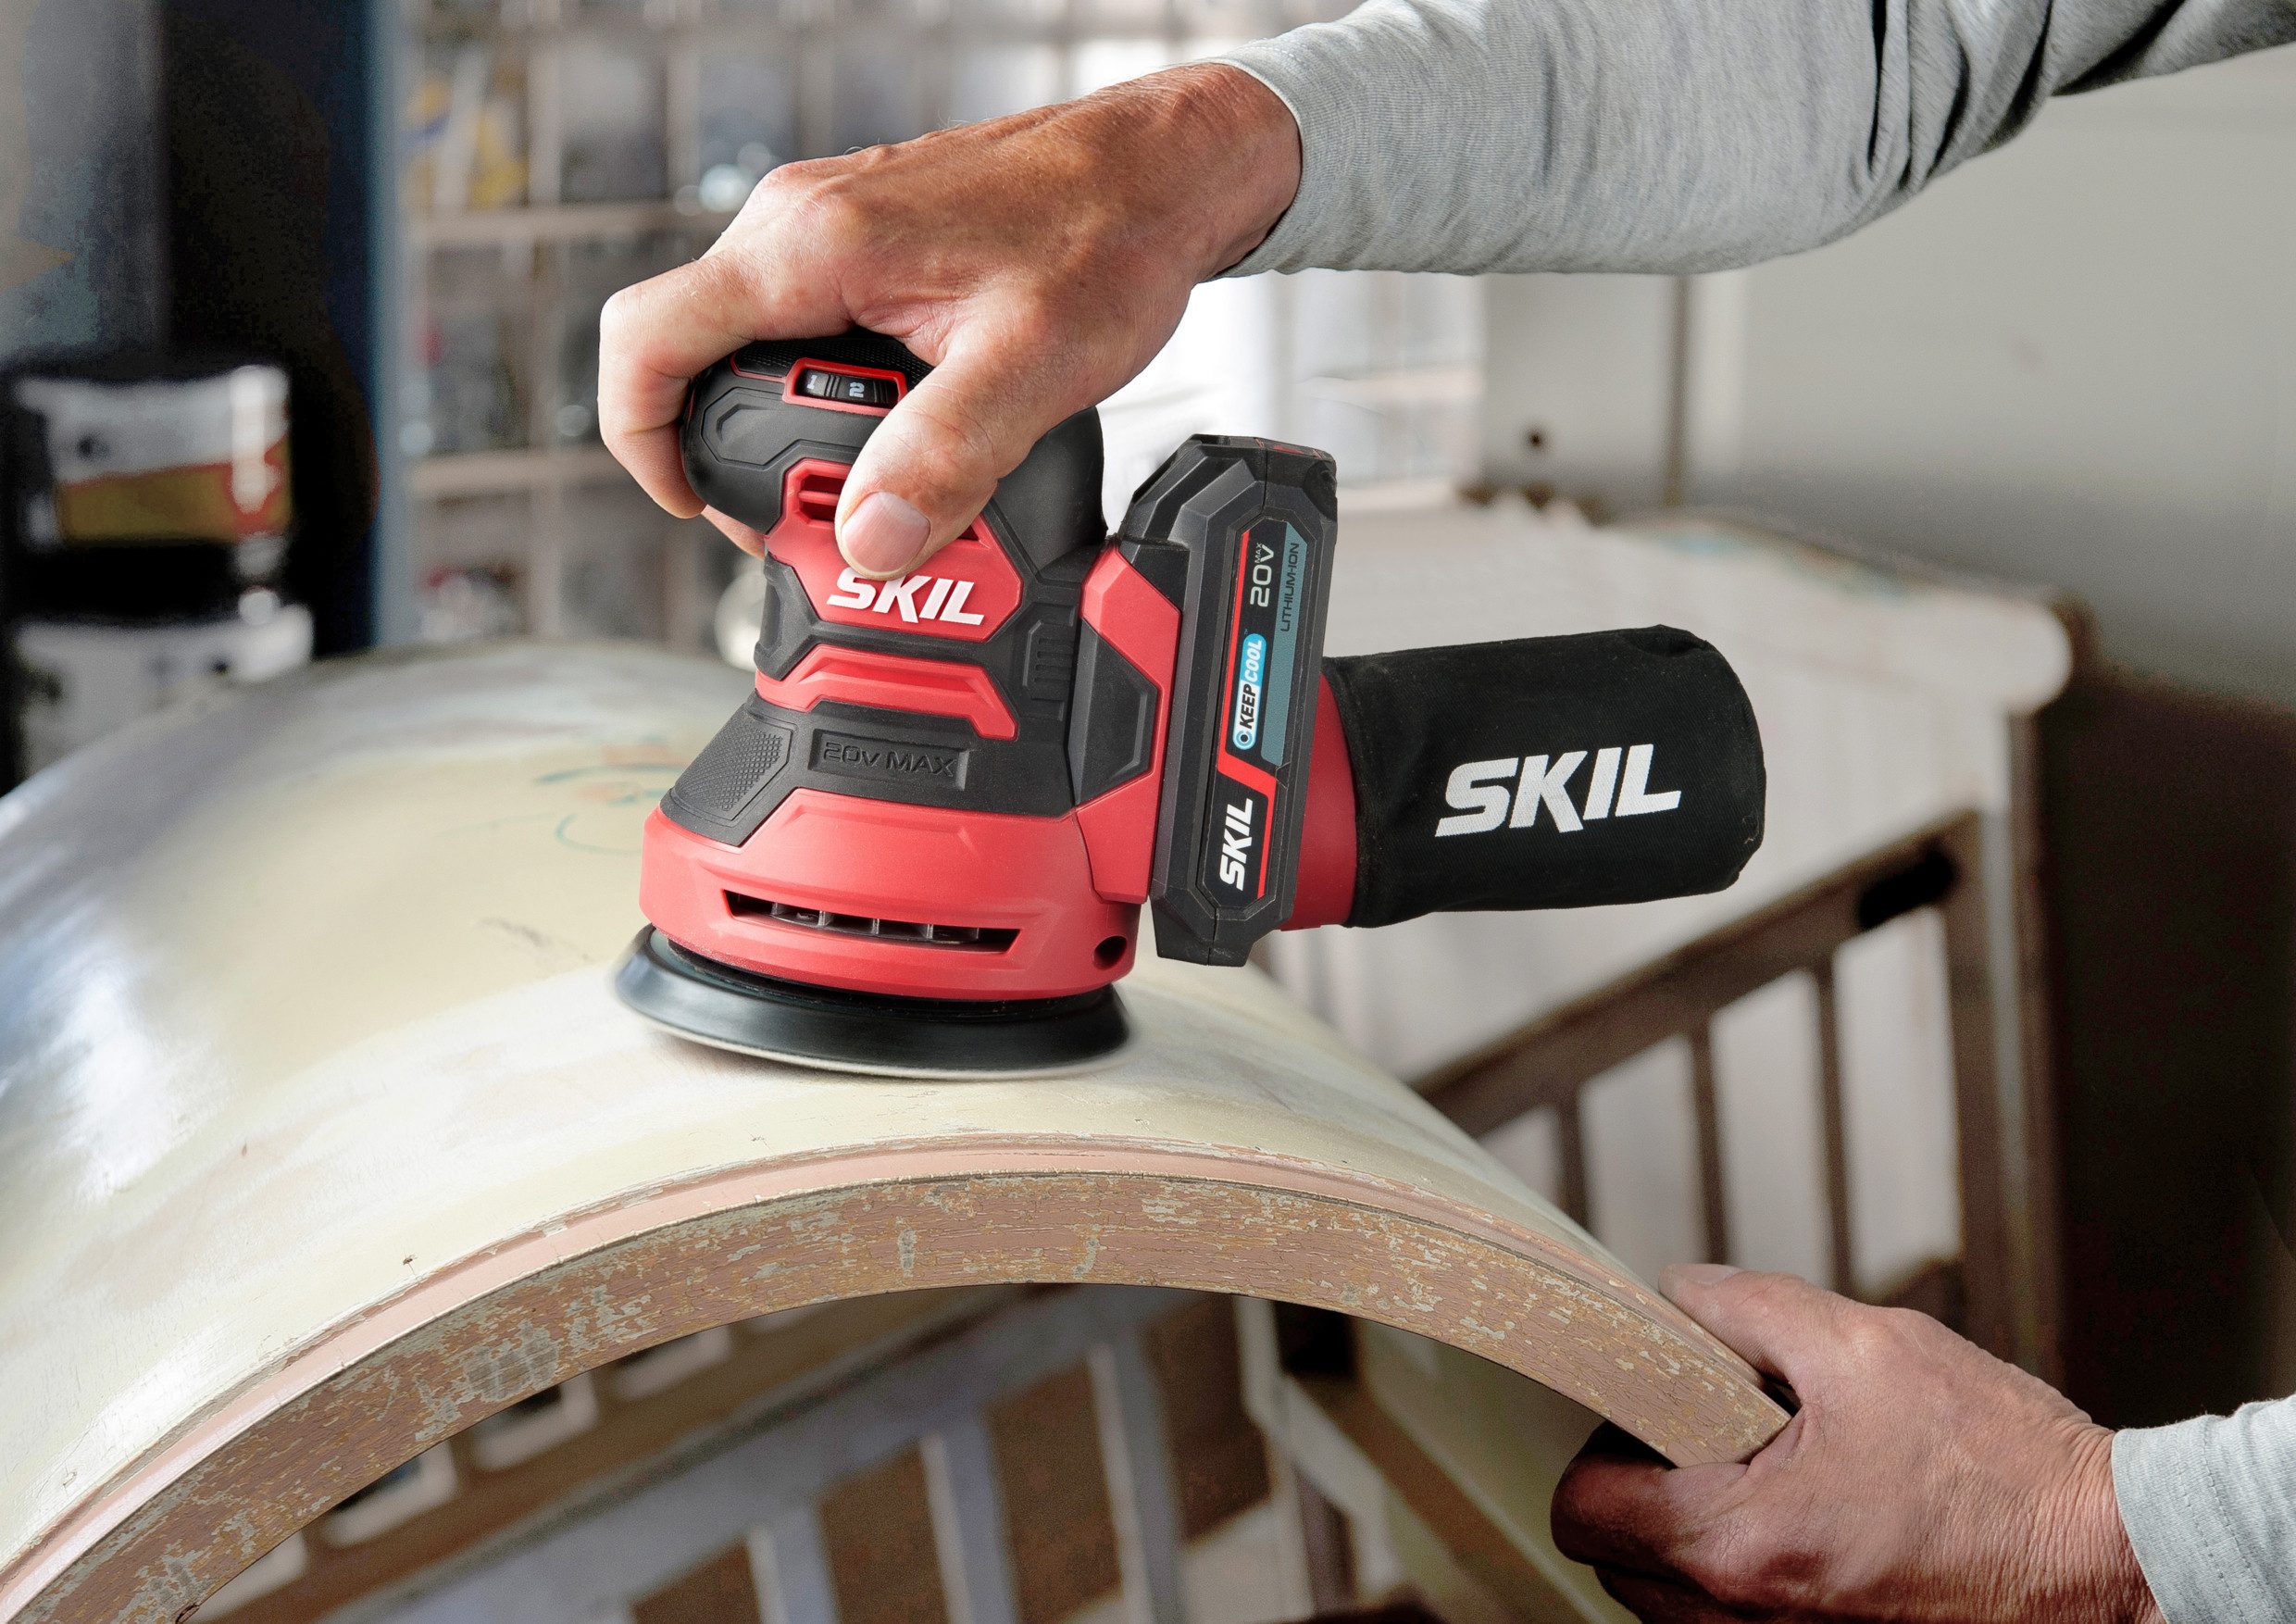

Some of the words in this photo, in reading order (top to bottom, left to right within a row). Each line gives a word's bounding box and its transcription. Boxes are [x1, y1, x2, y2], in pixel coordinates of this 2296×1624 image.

[806, 374, 817, 390] 1
[849, 381, 865, 398] 2
[826, 567, 985, 626] SKIL
[1249, 543, 1274, 607] 20V
[1280, 543, 1300, 632] LITHIUM-ION
[1244, 639, 1262, 682] COOL
[1239, 683, 1257, 730] KEEP
[885, 751, 958, 778] MAX
[1434, 743, 1681, 837] SKIL
[1219, 798, 1254, 891] SKIL
